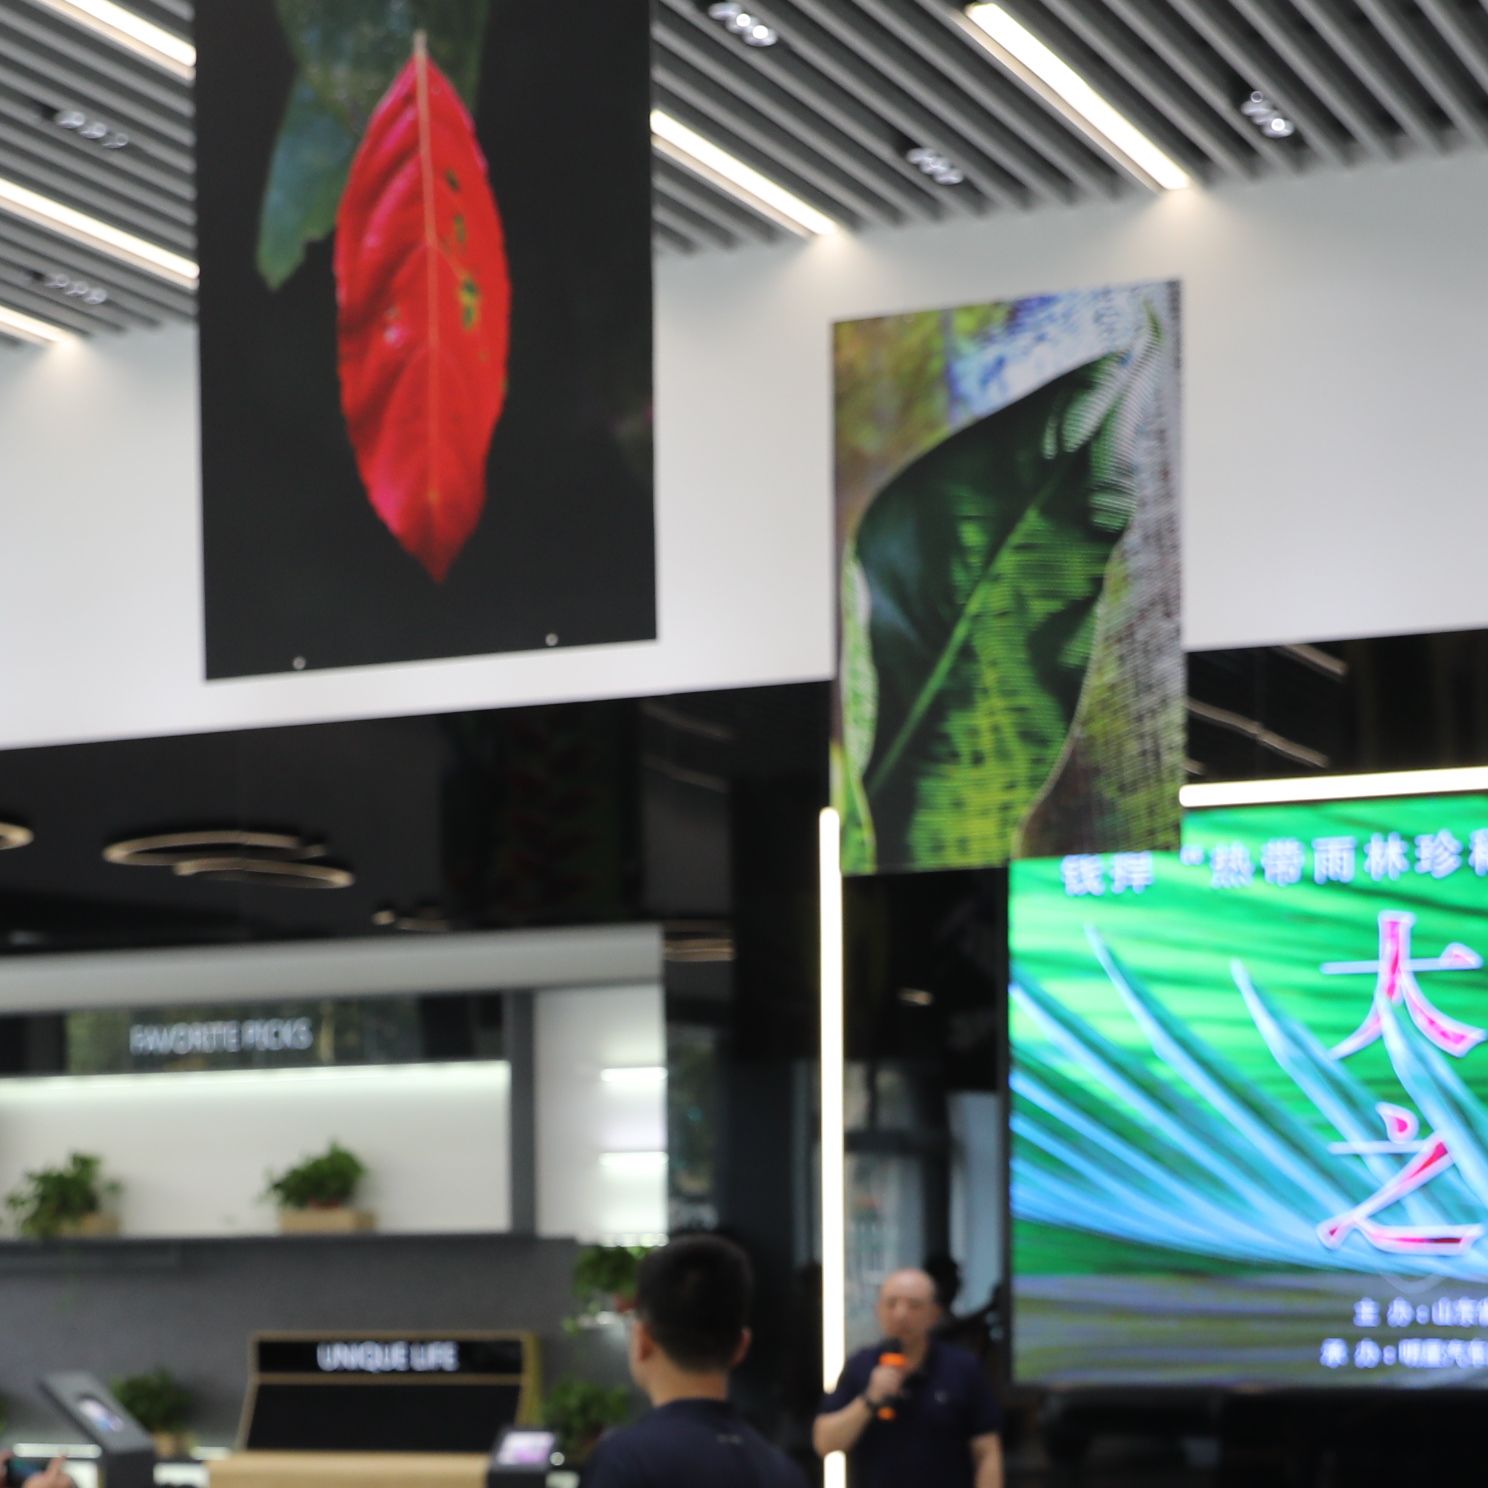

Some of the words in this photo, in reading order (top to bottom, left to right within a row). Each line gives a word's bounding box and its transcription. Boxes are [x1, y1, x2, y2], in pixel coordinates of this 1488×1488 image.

[130, 1020, 241, 1055] FAVORITE
[242, 1017, 313, 1050] PICKS
[317, 1340, 409, 1372] UNIQUE
[411, 1340, 459, 1371] LIFE
